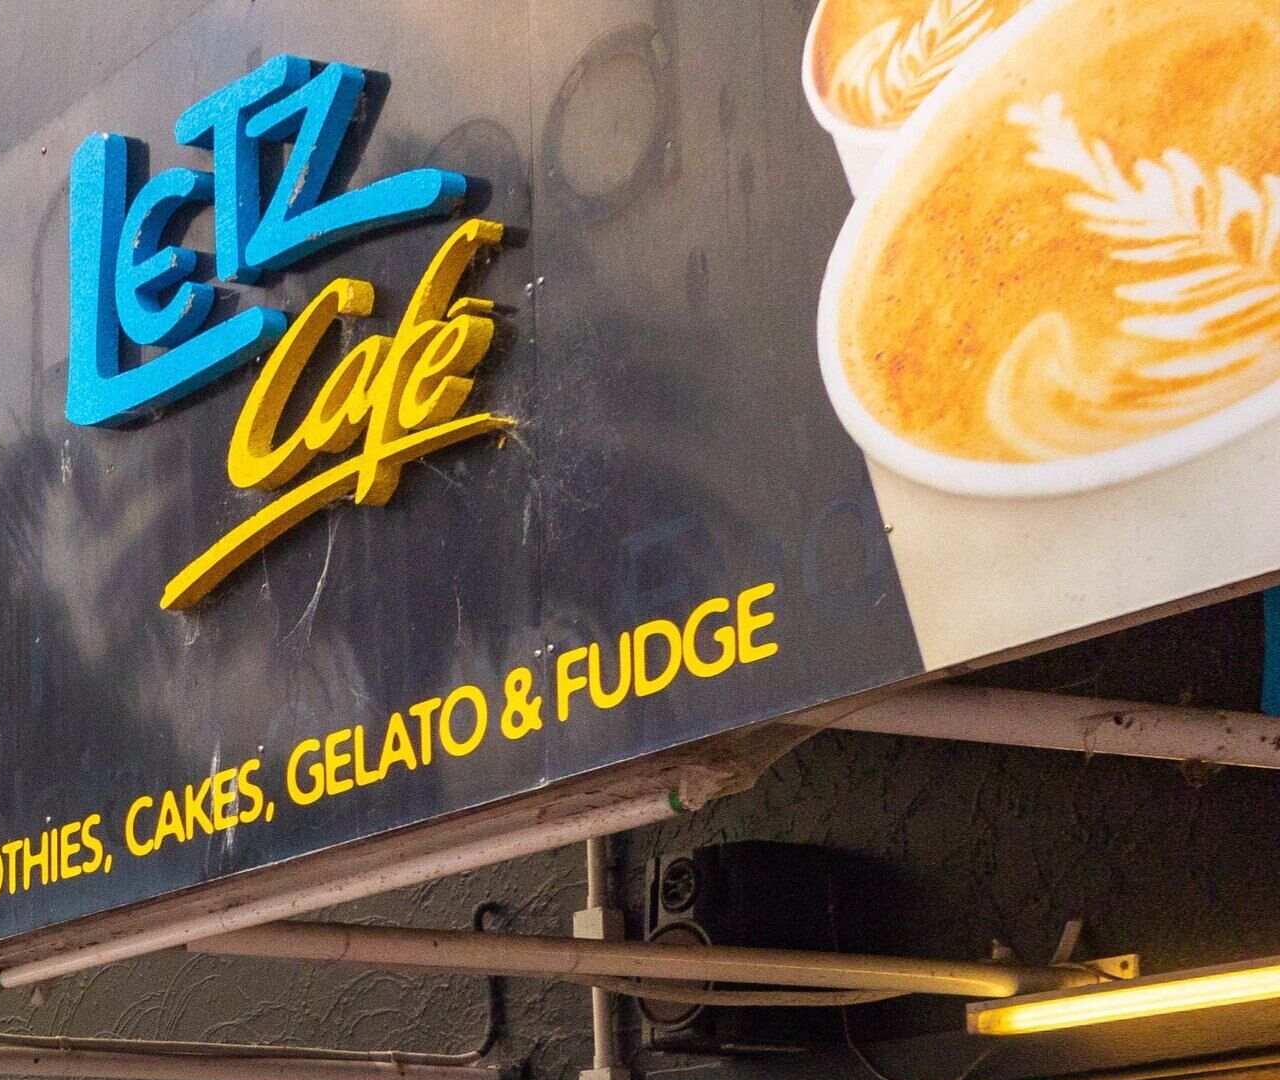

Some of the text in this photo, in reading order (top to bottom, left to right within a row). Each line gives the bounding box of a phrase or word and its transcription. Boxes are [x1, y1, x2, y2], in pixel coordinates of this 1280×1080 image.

[66, 53, 467, 427] LETZ
[126, 758, 275, 857] CAKES,
[286, 685, 488, 805] GELATO
[500, 667, 543, 740] &
[557, 582, 780, 723] FUDGE
